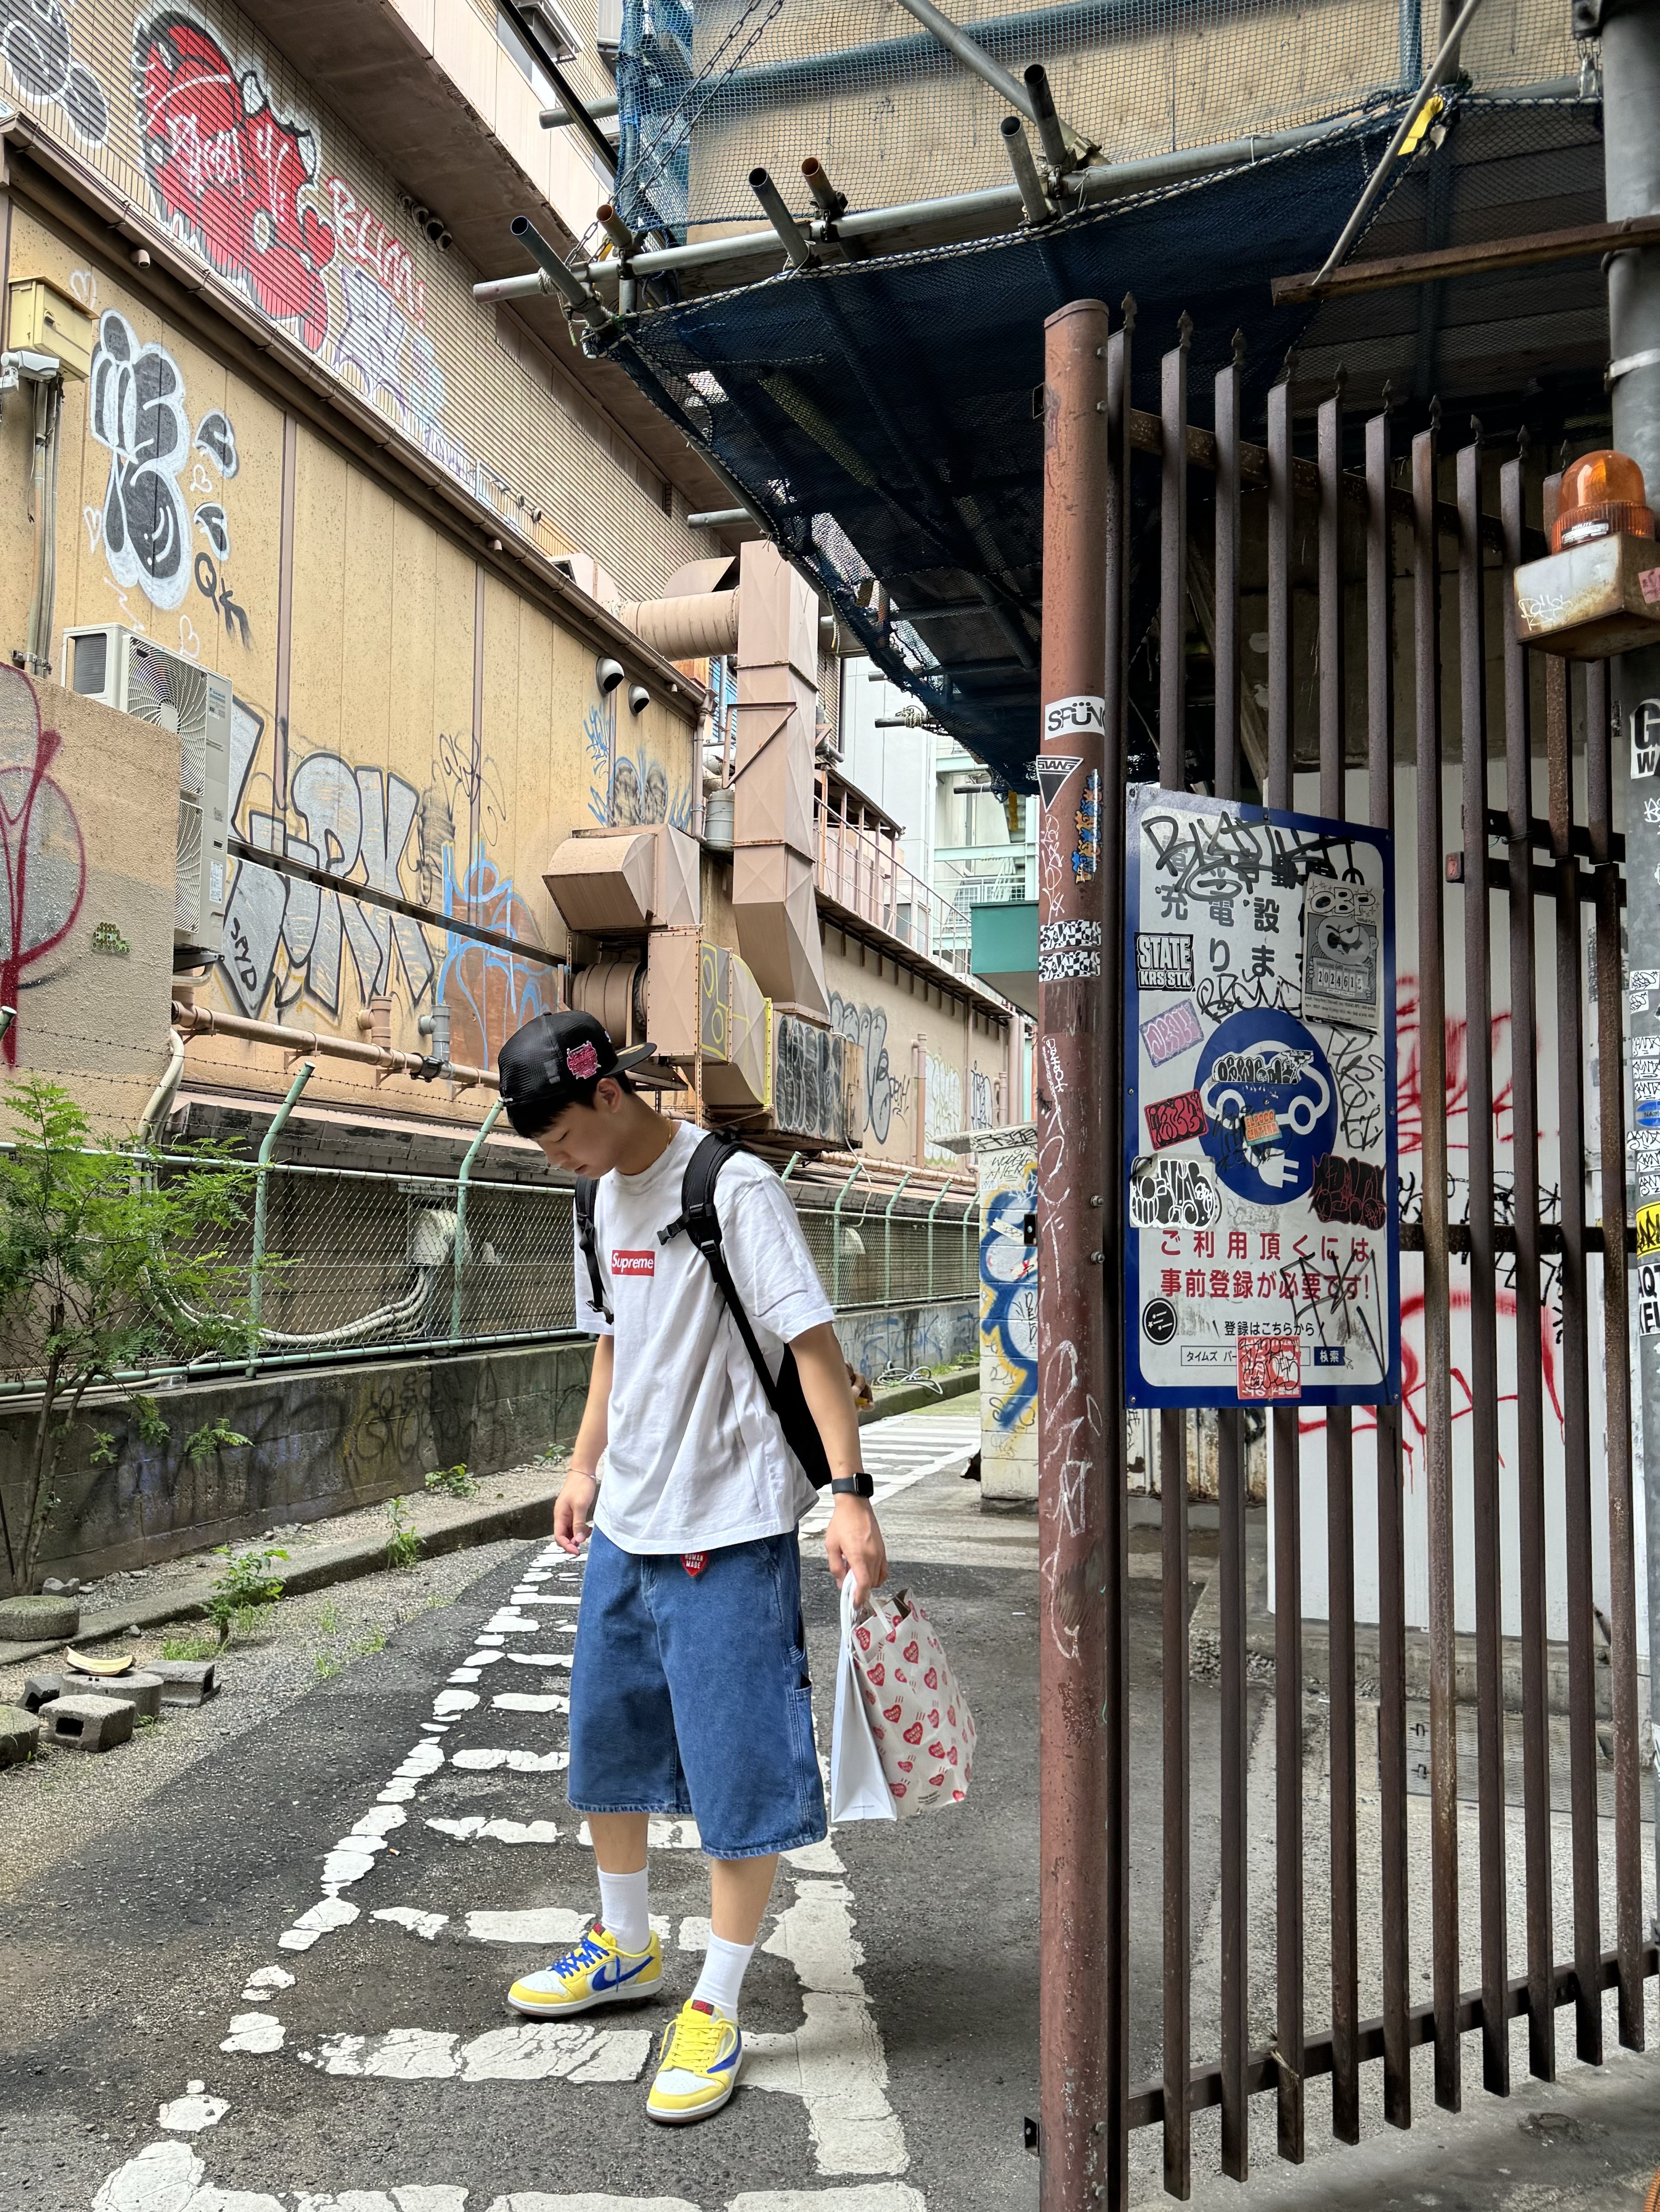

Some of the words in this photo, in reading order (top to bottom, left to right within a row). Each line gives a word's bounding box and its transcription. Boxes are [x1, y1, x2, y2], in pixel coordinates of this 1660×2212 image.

[1137, 935, 1191, 970] STATE
[1139, 970, 1165, 987] KRS
[1166, 971, 1192, 988] STK
[1161, 1230, 1369, 1263] ご利用頂くには
[612, 1253, 654, 1273] Supreme
[1224, 1321, 1315, 1336] 登録はこちらから
[1187, 1351, 1218, 1362] タイムズ
[1320, 1350, 1340, 1363] 検索
[686, 1559, 701, 1569] MADE
